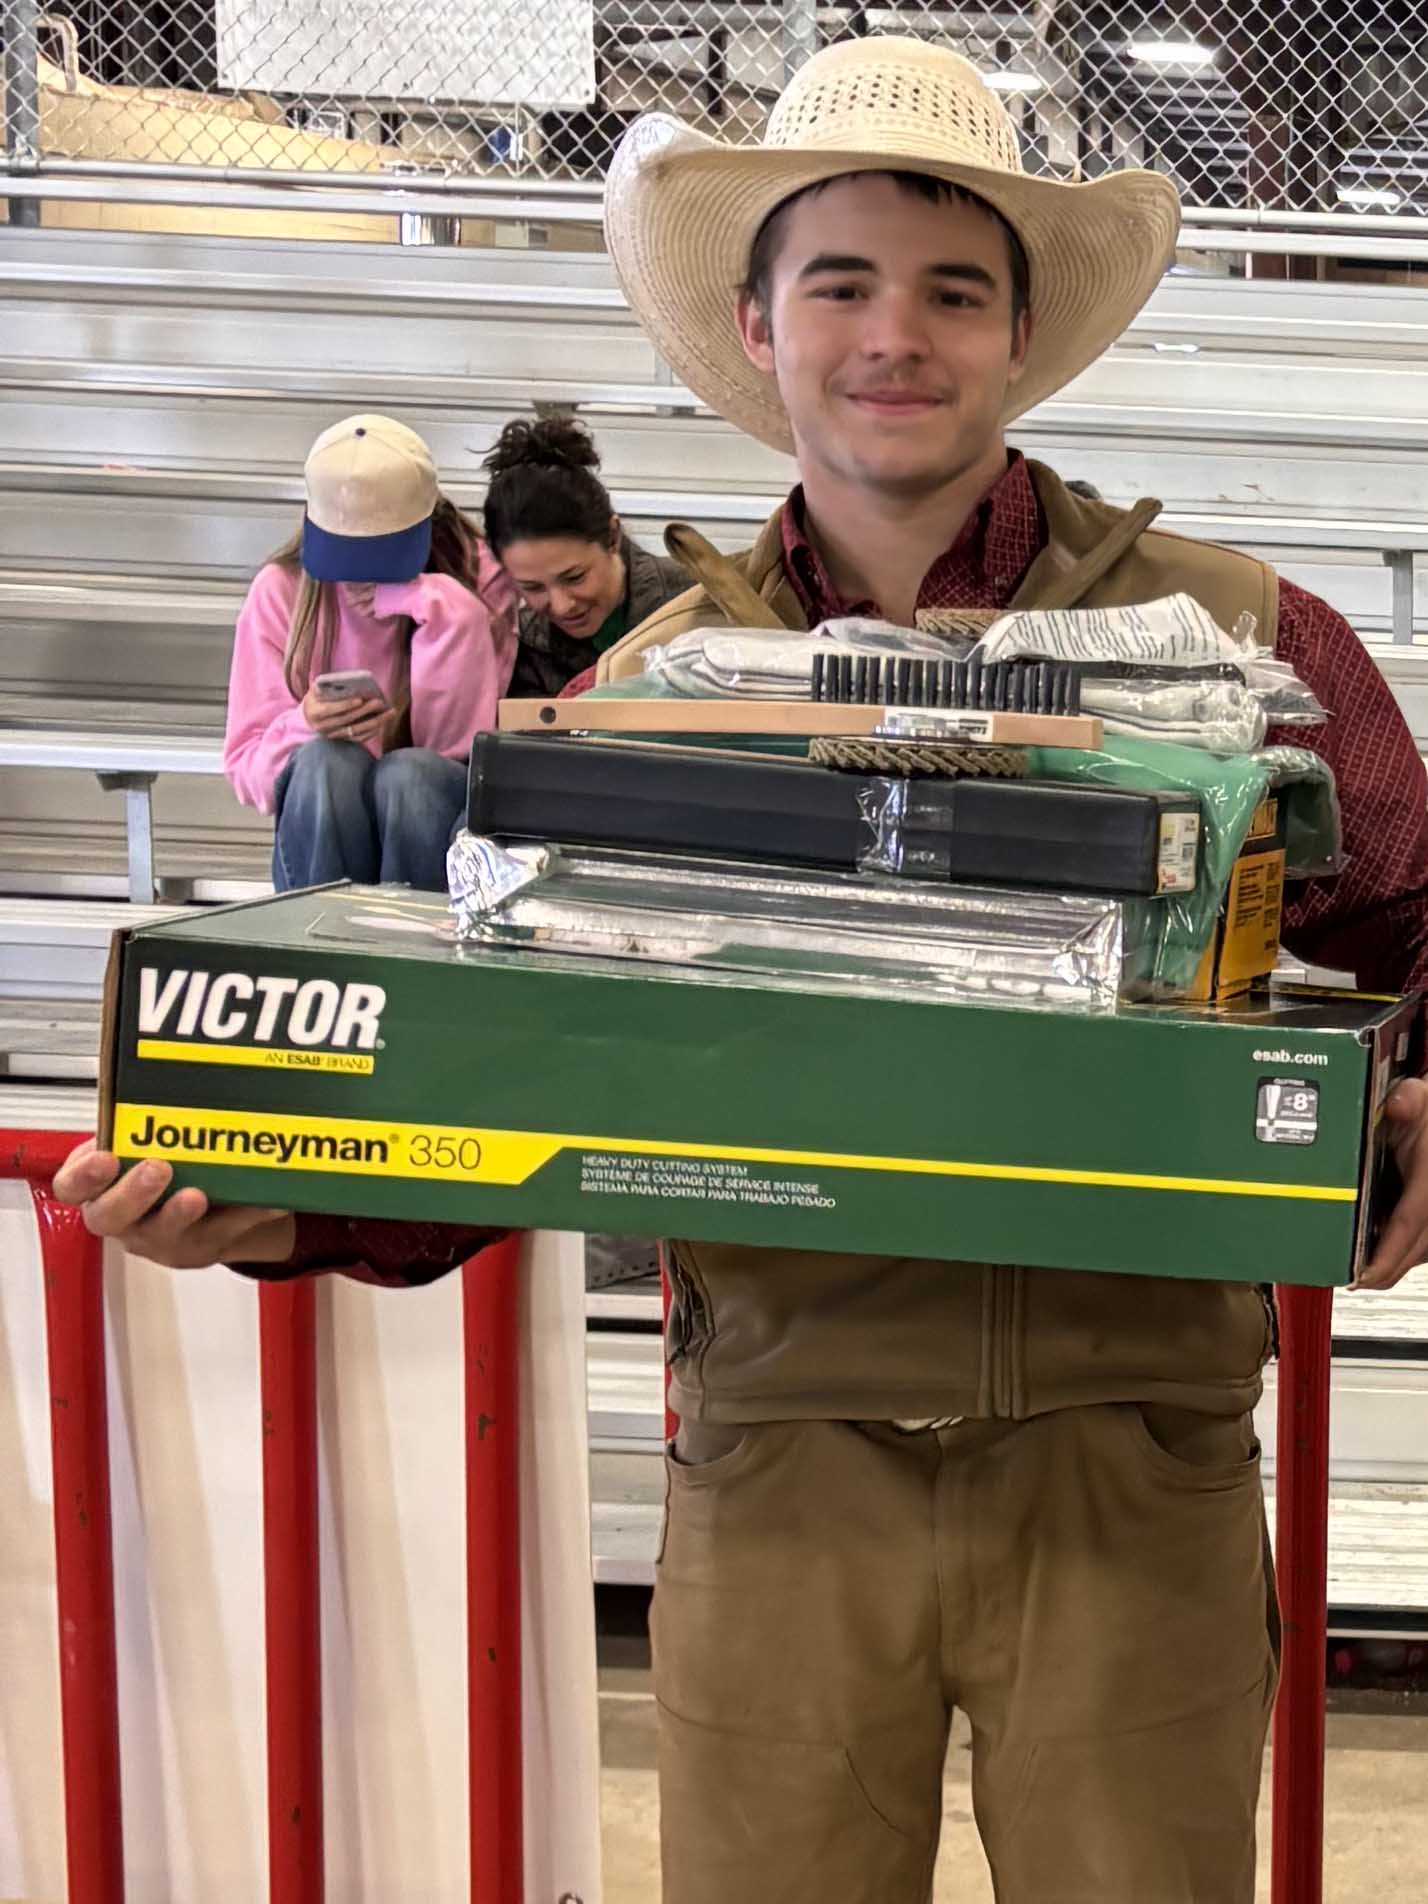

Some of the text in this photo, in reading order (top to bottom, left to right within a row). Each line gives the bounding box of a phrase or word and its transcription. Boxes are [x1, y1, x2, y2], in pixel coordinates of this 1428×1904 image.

[138, 967, 386, 1049] VICTOR
[264, 1053, 284, 1064] AN
[325, 1057, 369, 1070] BRAND
[1252, 1049, 1328, 1066] esab.com
[130, 1115, 482, 1171] Journeyman 350
[582, 1156, 747, 1175] HEAVY DUTY CUTTING SYSTEM
[635, 1171, 649, 1183] DE
[774, 1182, 818, 1195] INTENSE
